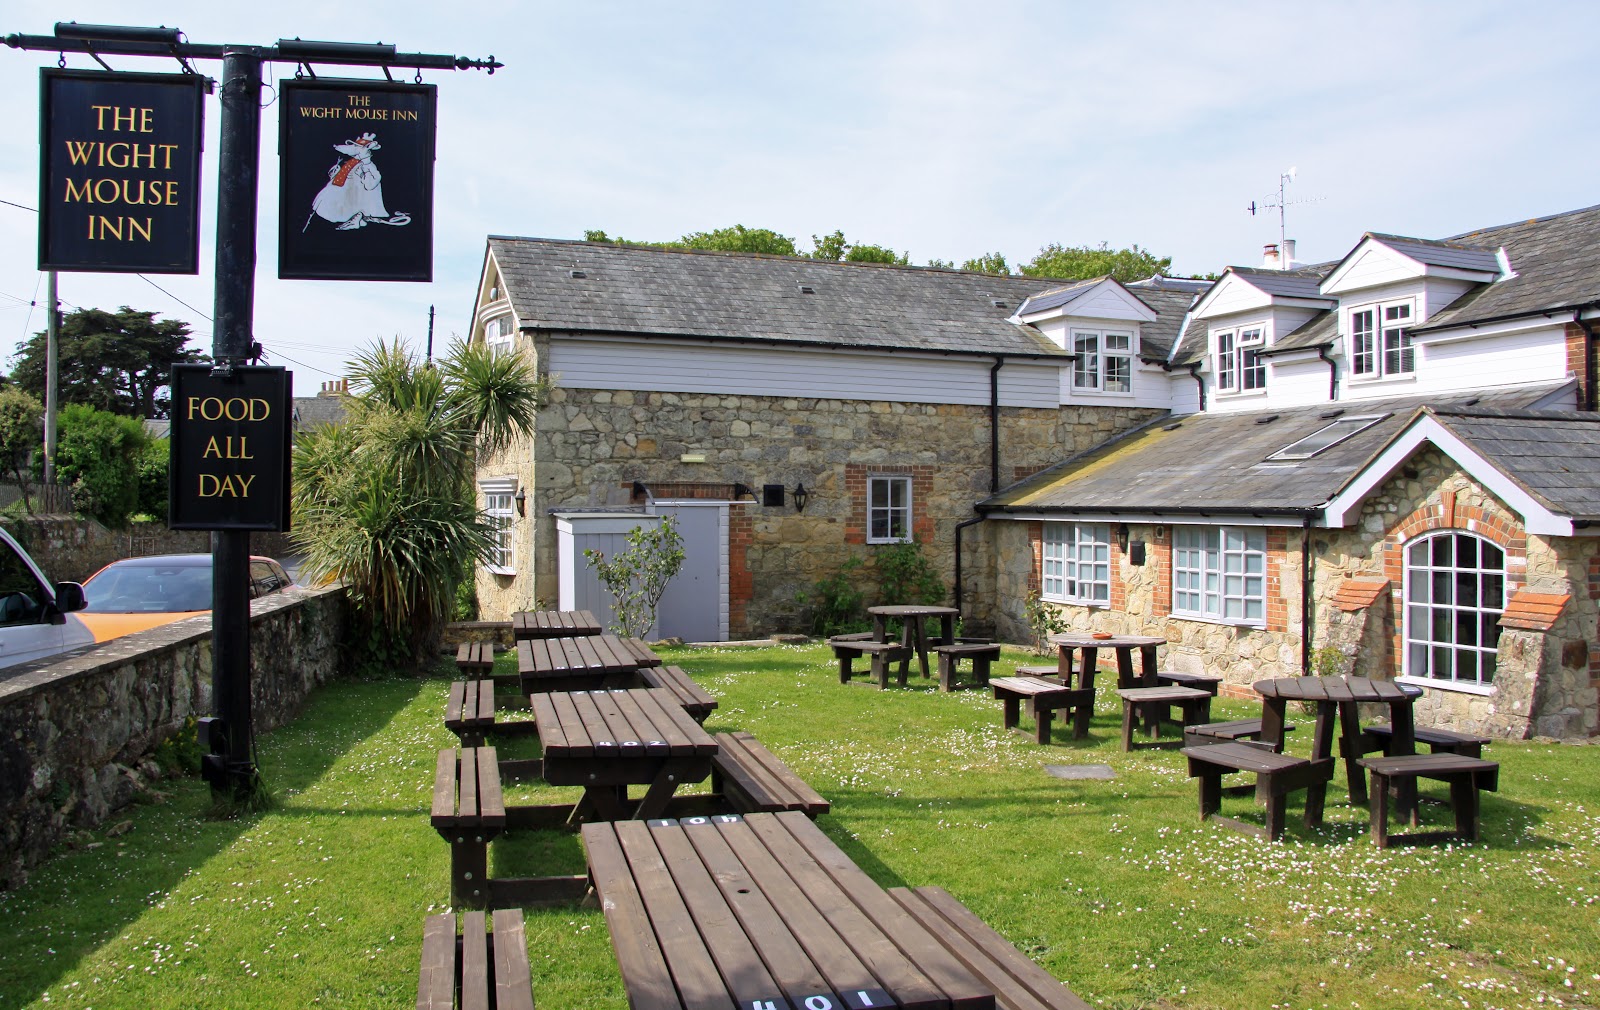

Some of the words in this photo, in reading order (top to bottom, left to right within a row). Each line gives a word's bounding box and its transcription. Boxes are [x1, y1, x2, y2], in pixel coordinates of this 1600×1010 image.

[300, 106, 342, 118] WIGHT
[345, 108, 388, 120] MOUSE
[392, 110, 418, 121] INN
[347, 95, 371, 106] THE
[91, 105, 154, 133] THE
[66, 141, 179, 169] WIGHT
[64, 177, 179, 206] MOUSE
[88, 215, 153, 242] INN
[187, 396, 270, 422] FOOD
[202, 435, 254, 459] ALL
[198, 474, 256, 498] DAY
